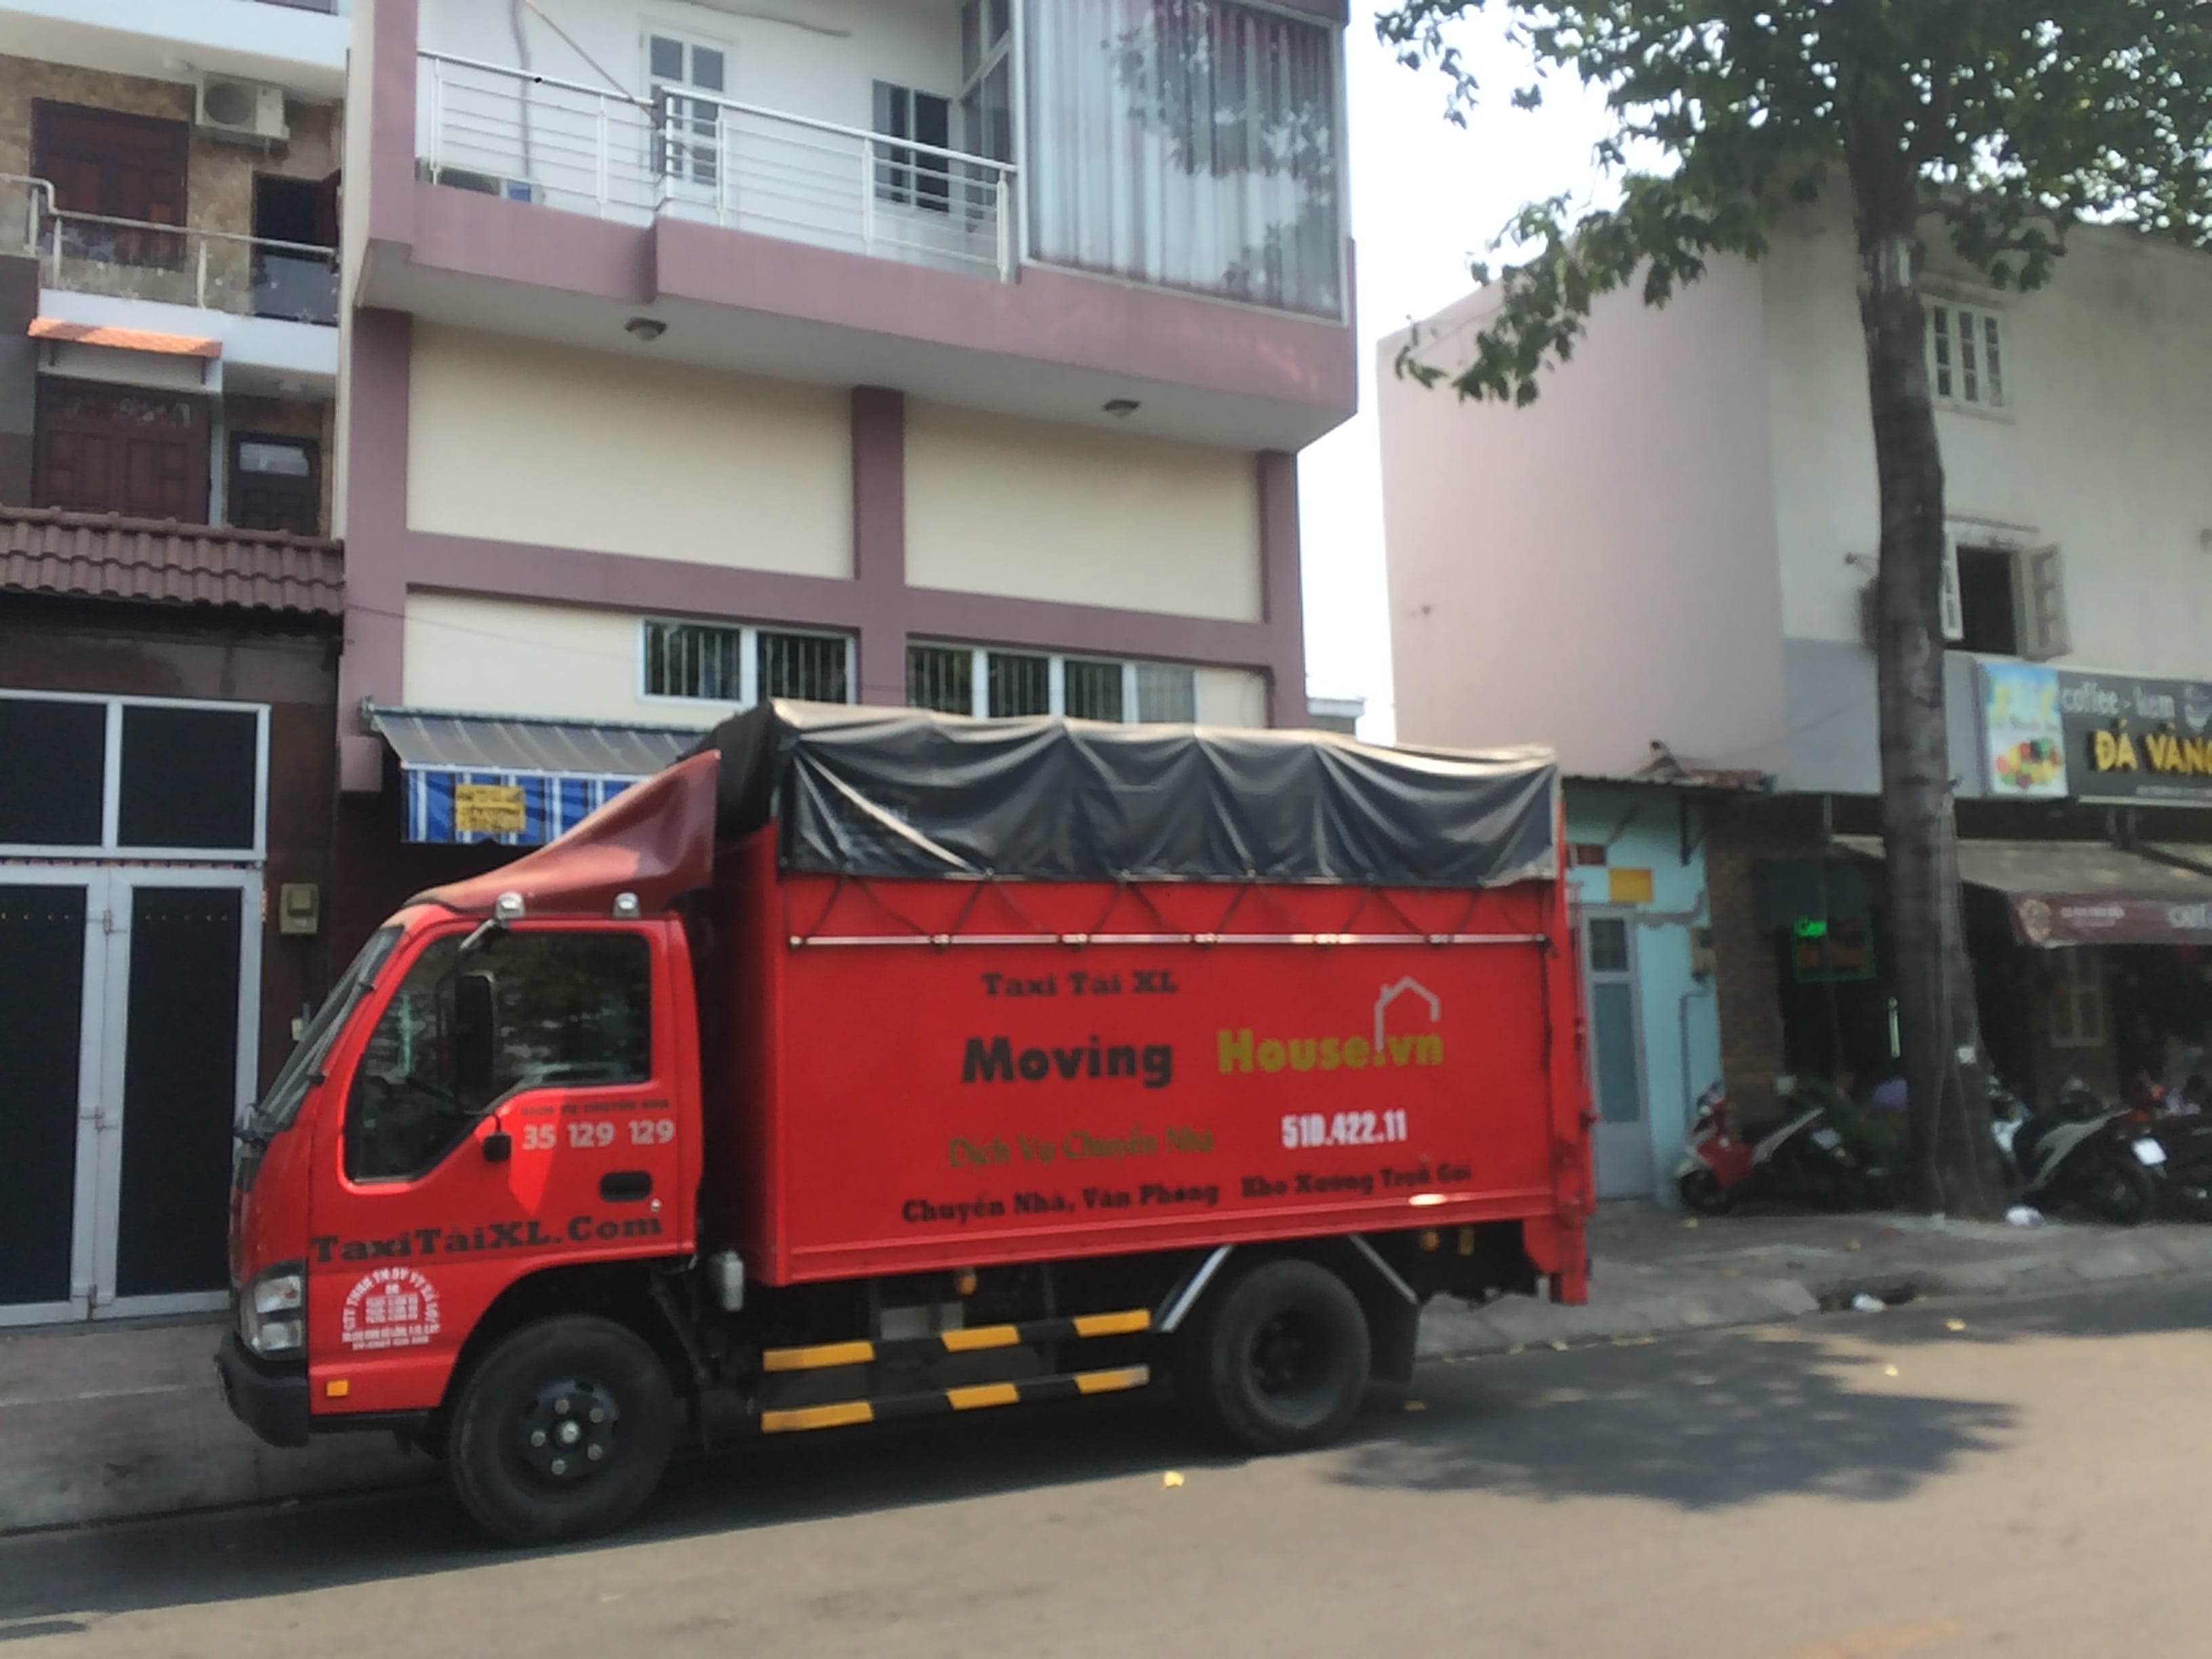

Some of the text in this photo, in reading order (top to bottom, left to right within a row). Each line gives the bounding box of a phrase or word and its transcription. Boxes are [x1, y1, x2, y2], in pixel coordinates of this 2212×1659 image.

[2092, 717, 2138, 771] ĐÁ
[981, 970, 1057, 998] Taxi
[1132, 968, 1179, 995] XL
[960, 1033, 1174, 1090] Moving
[1217, 1027, 1443, 1076] House.vn
[523, 1117, 676, 1151] 35 129 129
[1281, 1108, 1408, 1149] 510.422.11
